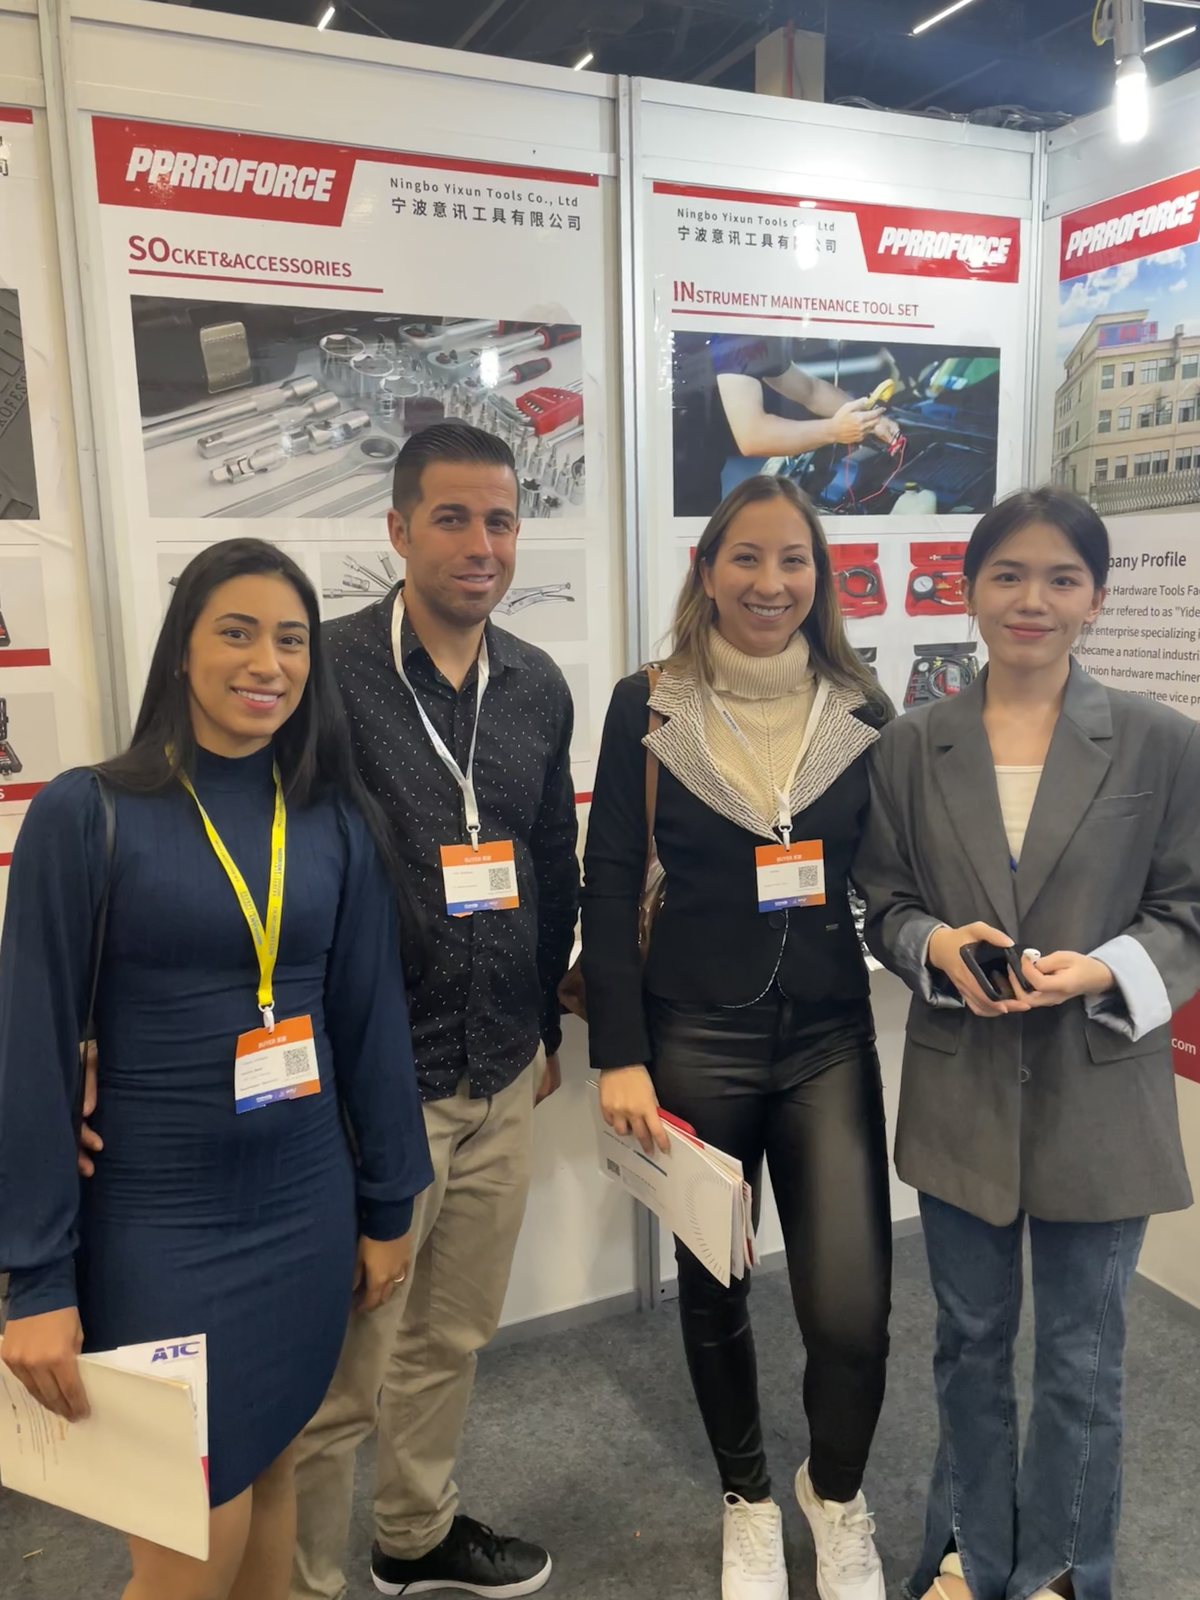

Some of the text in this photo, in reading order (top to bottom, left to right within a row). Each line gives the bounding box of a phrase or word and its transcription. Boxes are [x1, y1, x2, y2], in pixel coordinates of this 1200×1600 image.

[125, 147, 337, 202] PPRROFORCE
[390, 178, 579, 207] Ningbo Yixun Tools Co., Ltd
[391, 197, 582, 231] 宁波意讯工具有限公司
[677, 208, 718, 222] Ningbo
[722, 212, 753, 224] Yixun
[758, 216, 788, 227] Tools
[818, 222, 835, 232] Ltd
[1065, 190, 1200, 261] PPRROFORCE
[677, 225, 837, 254] 宁波意讯工具有司
[877, 226, 1012, 264] PPRROFORCE
[128, 235, 352, 278] SOCKET&ACCESSORIES
[673, 280, 919, 317] INSTRUMENT MAINTENANCE TOOL SET
[1108, 551, 1187, 571] pany Profile
[1113, 585, 1157, 596] Hardware
[1160, 584, 1185, 596] Tools
[1116, 605, 1148, 616] refered
[1150, 607, 1160, 617] to
[1162, 608, 1173, 617] as
[1095, 626, 1139, 639] enterprise
[1140, 627, 1196, 642] specializing
[1081, 644, 1115, 656] became
[1116, 648, 1121, 657] a
[1123, 647, 1161, 659] national
[1084, 665, 1109, 676] Union
[1111, 666, 1154, 679] hardware
[1169, 691, 1189, 703] vice
[1171, 1038, 1197, 1056] com
[151, 1341, 201, 1363] ATC
